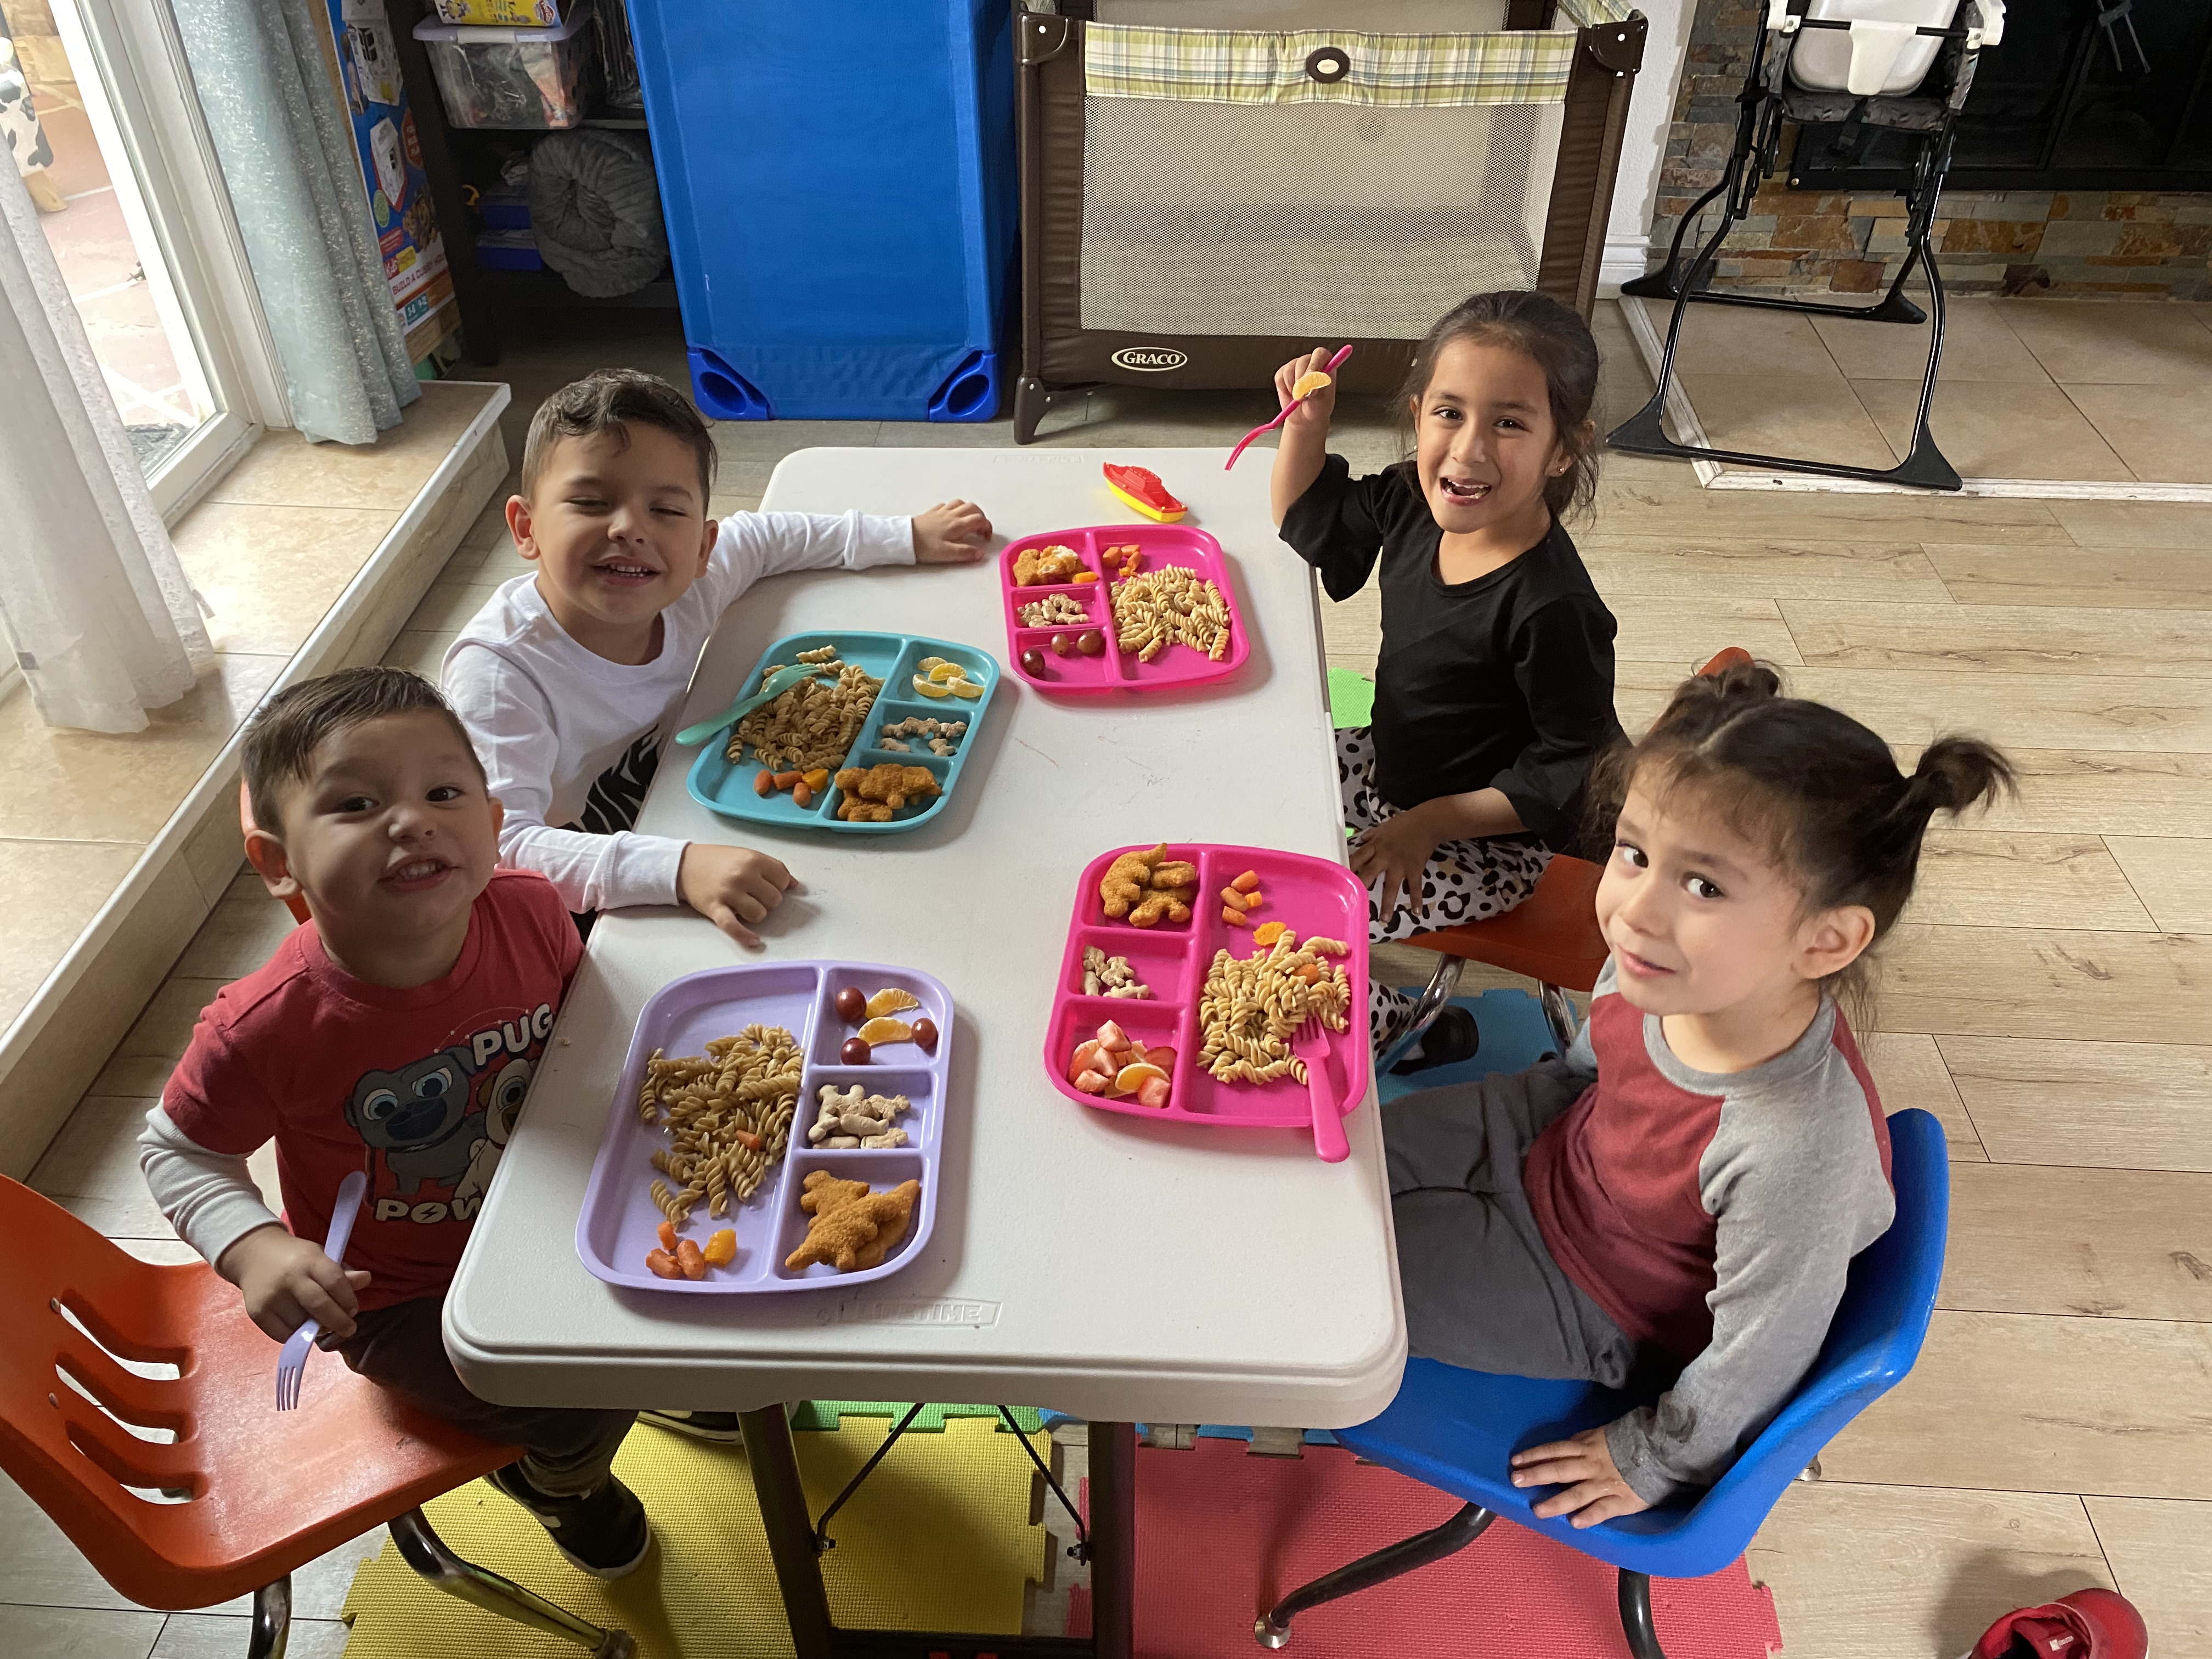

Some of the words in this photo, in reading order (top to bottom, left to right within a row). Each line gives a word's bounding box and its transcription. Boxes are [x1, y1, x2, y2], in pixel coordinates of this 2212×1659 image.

[392, 277, 410, 295] BUILD
[1122, 351, 1180, 365] GRACO
[473, 1003, 553, 1066] PUG
